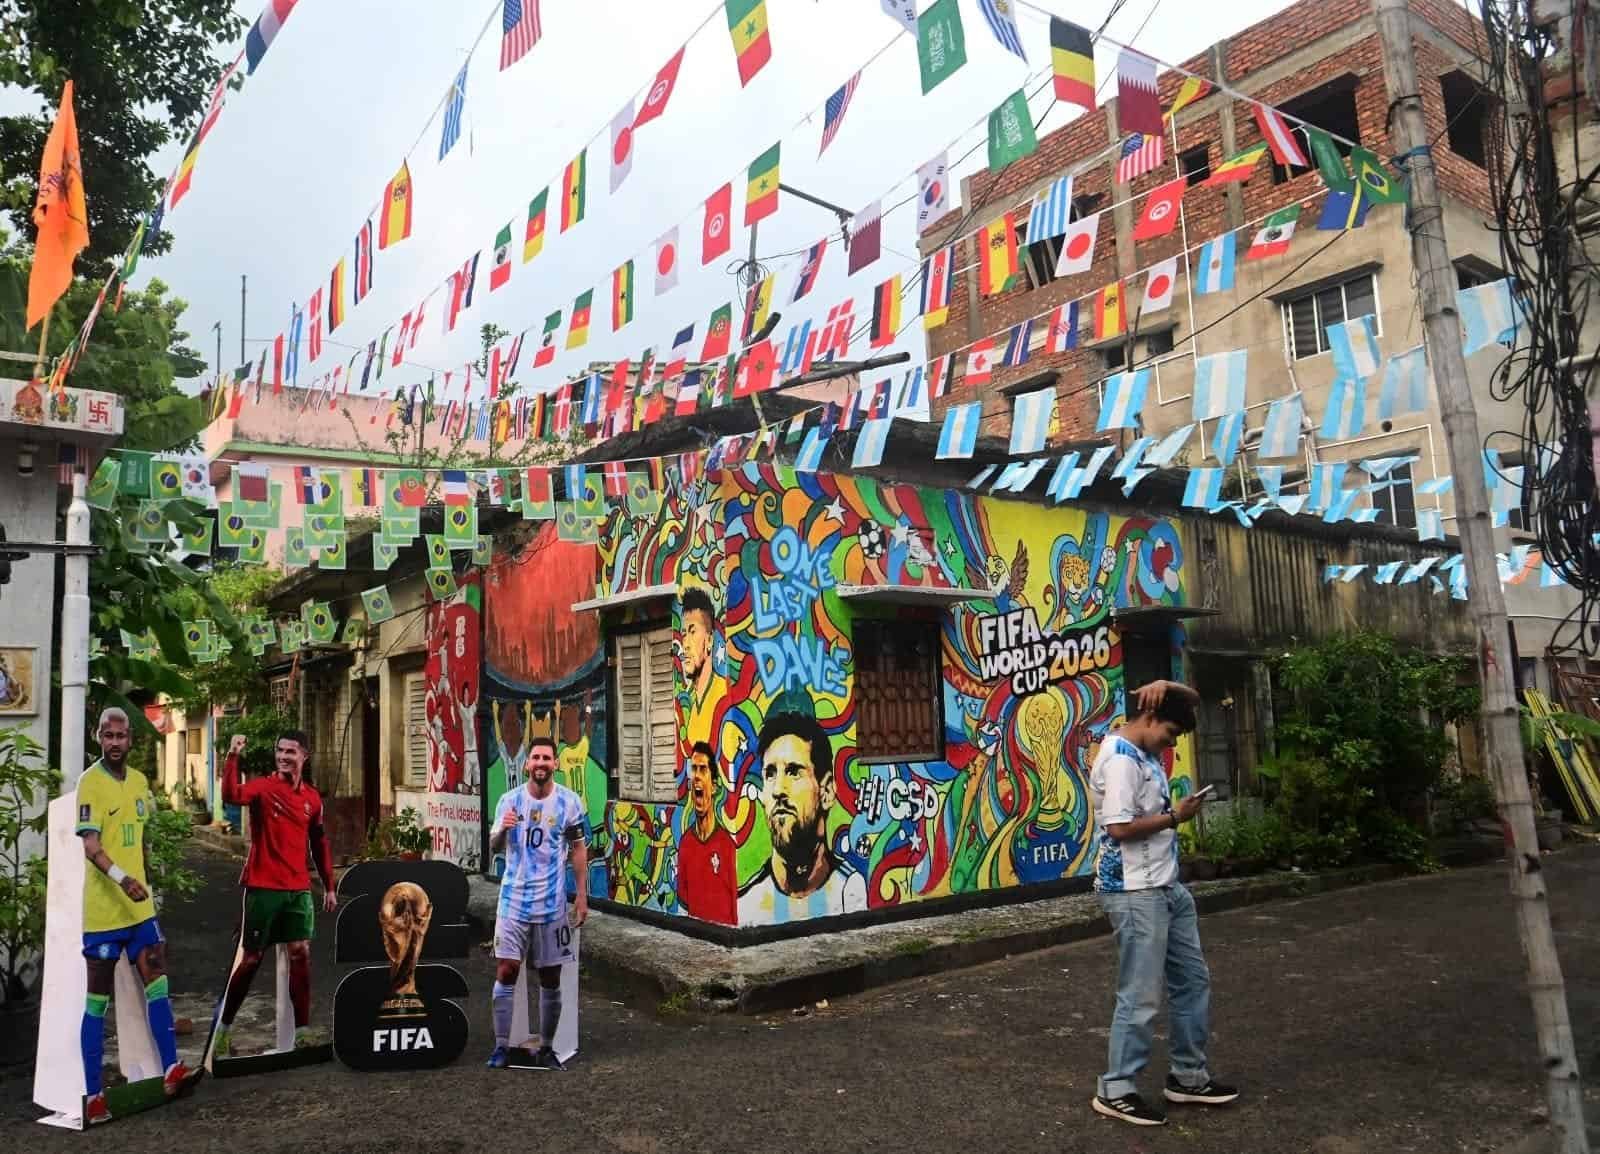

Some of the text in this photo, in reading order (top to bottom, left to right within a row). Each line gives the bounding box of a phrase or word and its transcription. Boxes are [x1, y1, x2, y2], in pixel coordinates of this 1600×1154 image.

[770, 525, 835, 588] ONE
[751, 575, 819, 633] LAST
[980, 607, 1041, 654] FIFA
[751, 632, 849, 697] DANCE
[979, 643, 1047, 681] WORLD
[1048, 626, 1110, 680] 2026
[1012, 666, 1049, 695] CUP
[122, 823, 135, 848] 10
[525, 827, 544, 849] 10
[1033, 842, 1070, 865] FIFA
[555, 925, 571, 948] 10
[373, 1027, 434, 1052] FIFA
